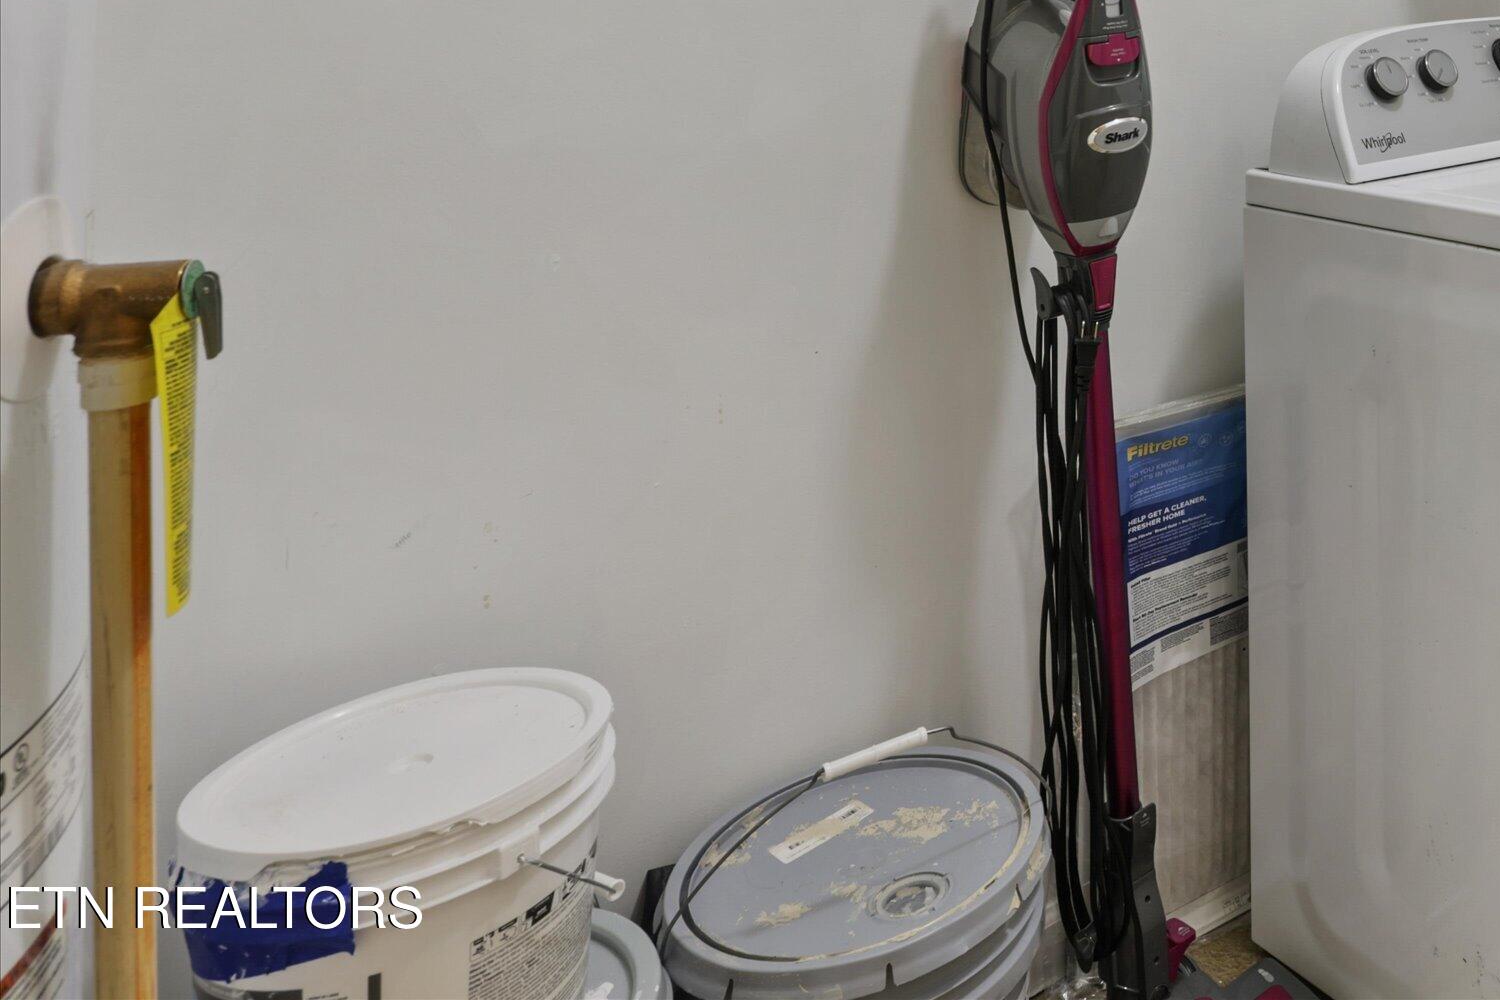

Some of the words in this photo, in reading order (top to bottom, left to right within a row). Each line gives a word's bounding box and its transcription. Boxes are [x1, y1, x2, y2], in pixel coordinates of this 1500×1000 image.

[1104, 127, 1140, 145] Shark
[1361, 131, 1407, 153] Whirlpool
[1127, 434, 1189, 462] Filtrete
[1128, 514, 1147, 527] HELP
[1147, 509, 1162, 519] GET
[1171, 495, 1207, 512] CLEANER,
[1128, 518, 1162, 535] FRESHER
[1162, 510, 1186, 522] HOME
